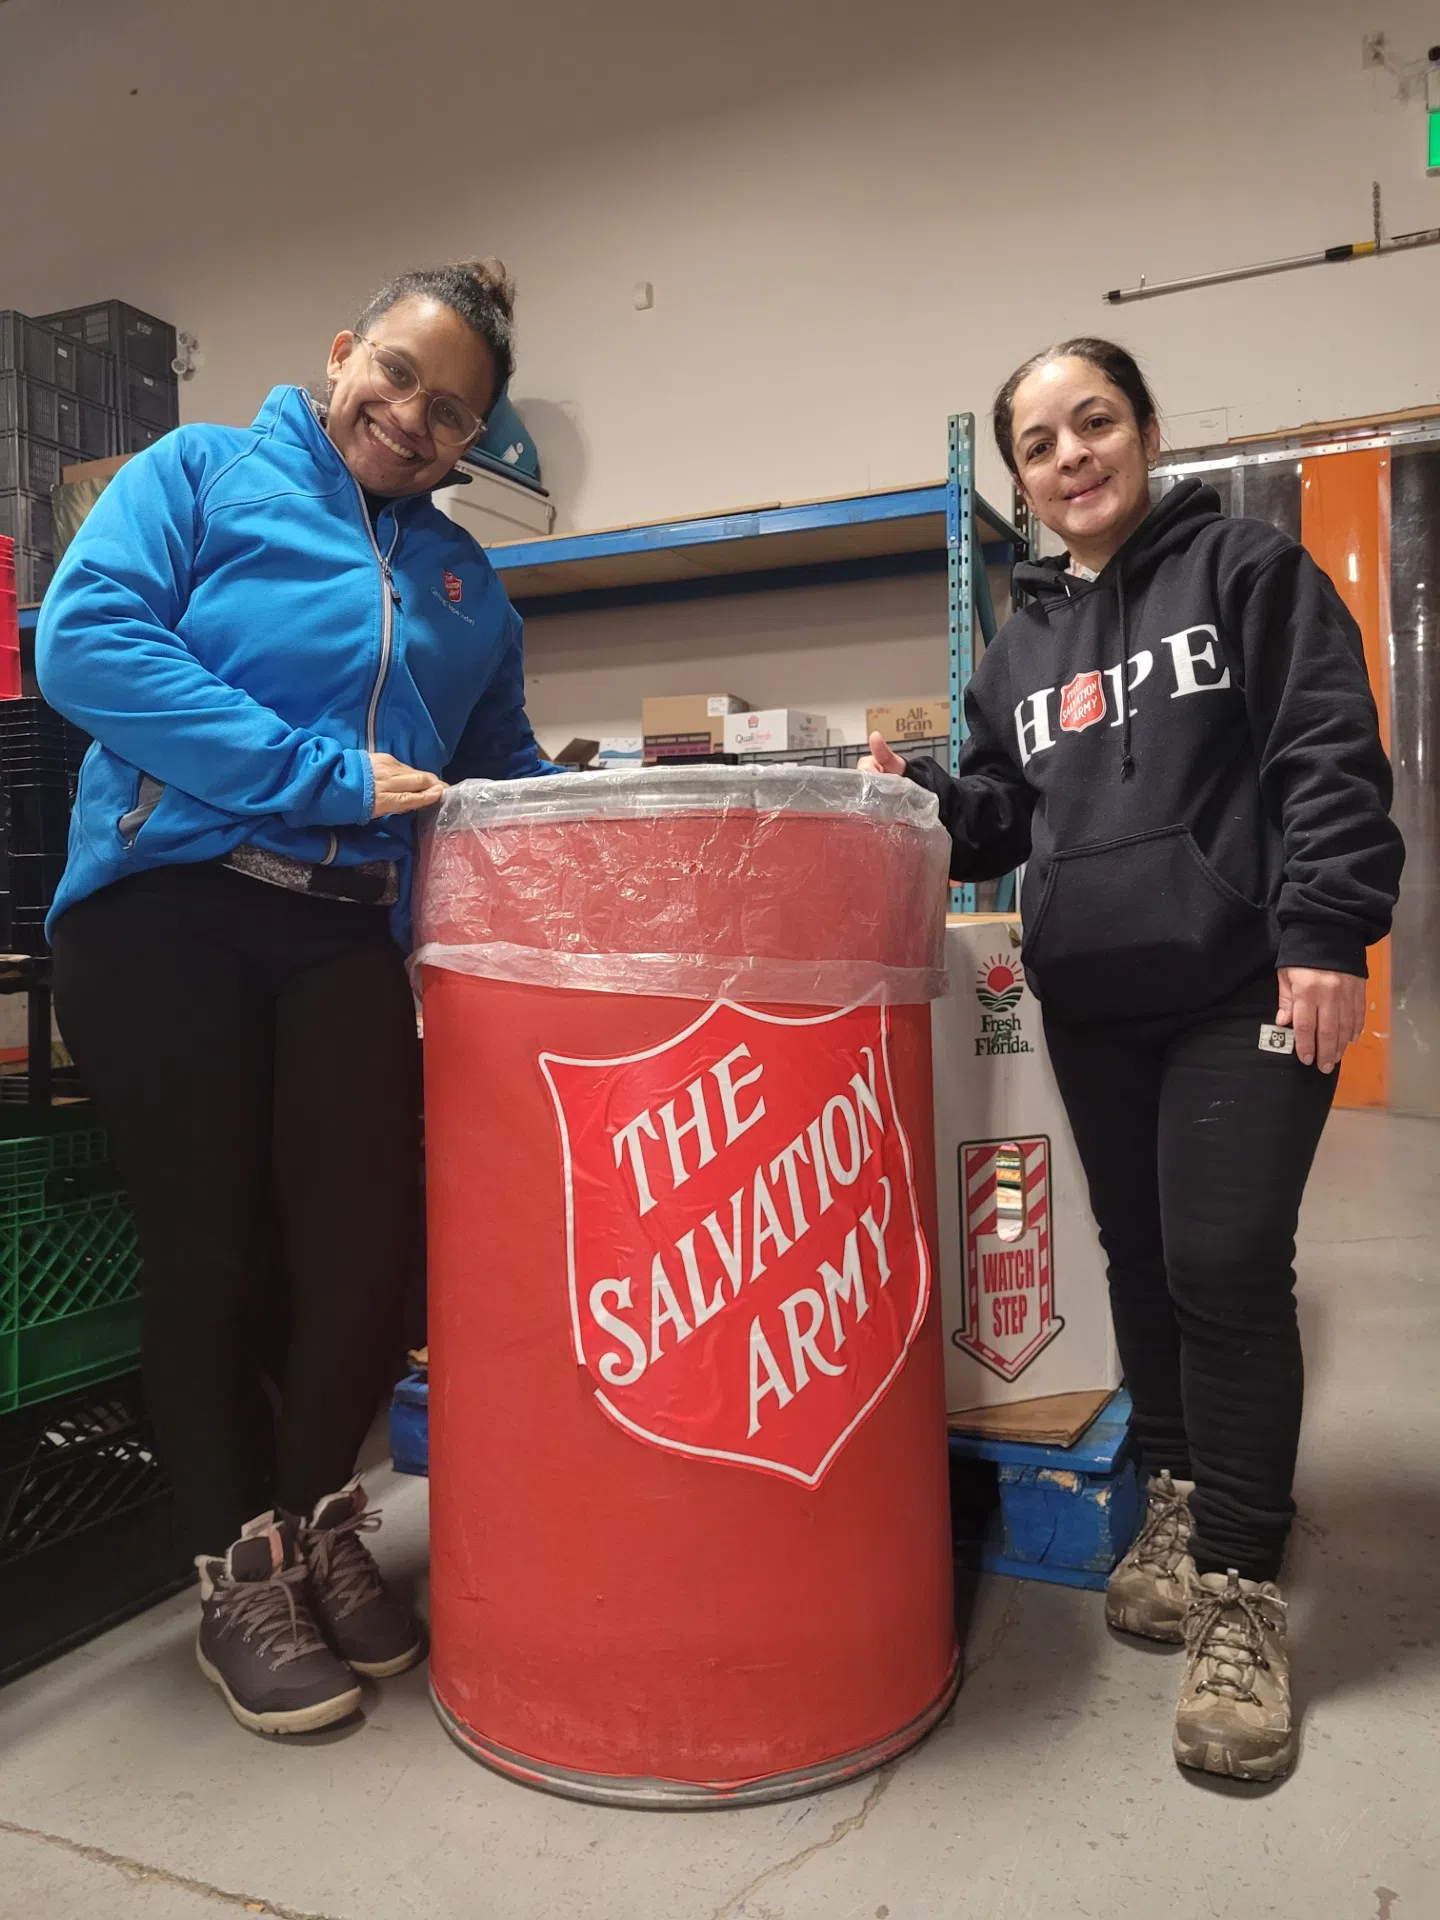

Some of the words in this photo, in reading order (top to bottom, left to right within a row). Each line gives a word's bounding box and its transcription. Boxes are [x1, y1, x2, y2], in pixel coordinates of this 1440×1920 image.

[907, 707, 928, 720] All-
[1014, 624, 1231, 768] HPE
[1073, 695, 1098, 722] ARMY
[895, 717, 932, 732] Bran
[981, 1012, 1022, 1033] Fresh
[612, 1042, 766, 1217] THE
[589, 1046, 885, 1386] SALVATION
[982, 1248, 1035, 1293] WATCH
[747, 1176, 892, 1440] ARMY
[992, 1294, 1028, 1338] STEP
